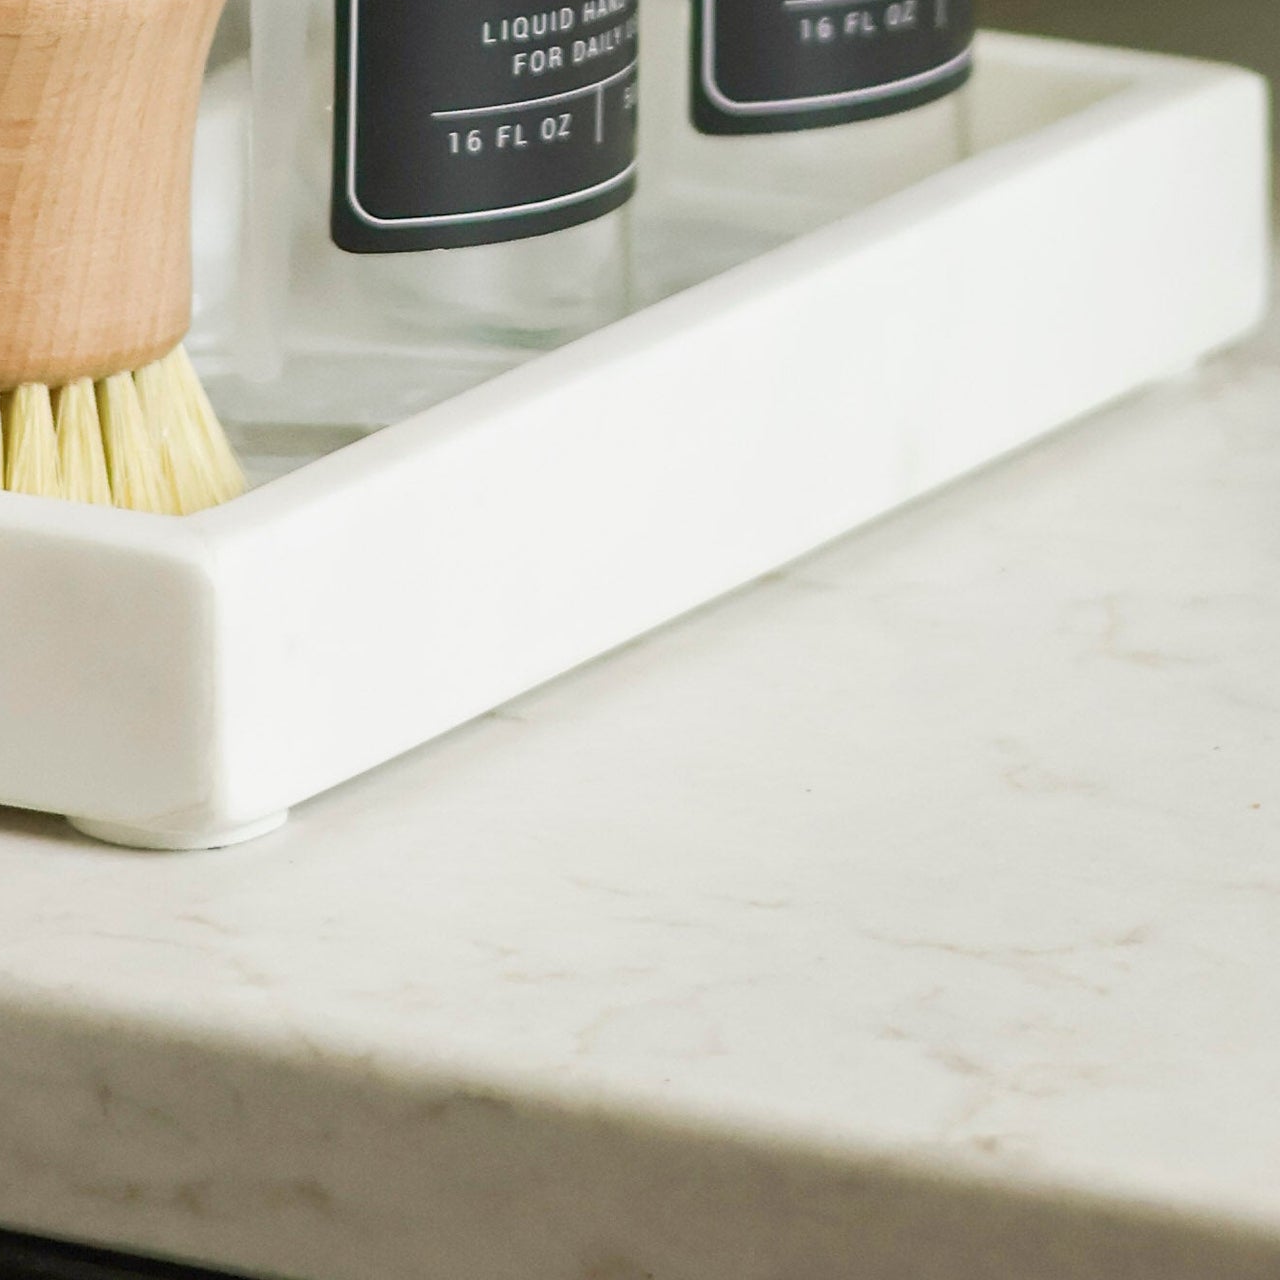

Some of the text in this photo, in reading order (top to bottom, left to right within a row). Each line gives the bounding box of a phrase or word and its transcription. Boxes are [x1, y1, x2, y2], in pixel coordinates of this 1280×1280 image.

[482, 7, 574, 44] LIQUID
[799, 0, 918, 41] 16 FL OZ
[512, 46, 564, 75] FOR
[572, 25, 622, 63] DAILY
[448, 113, 573, 154] 16 FL OZ
